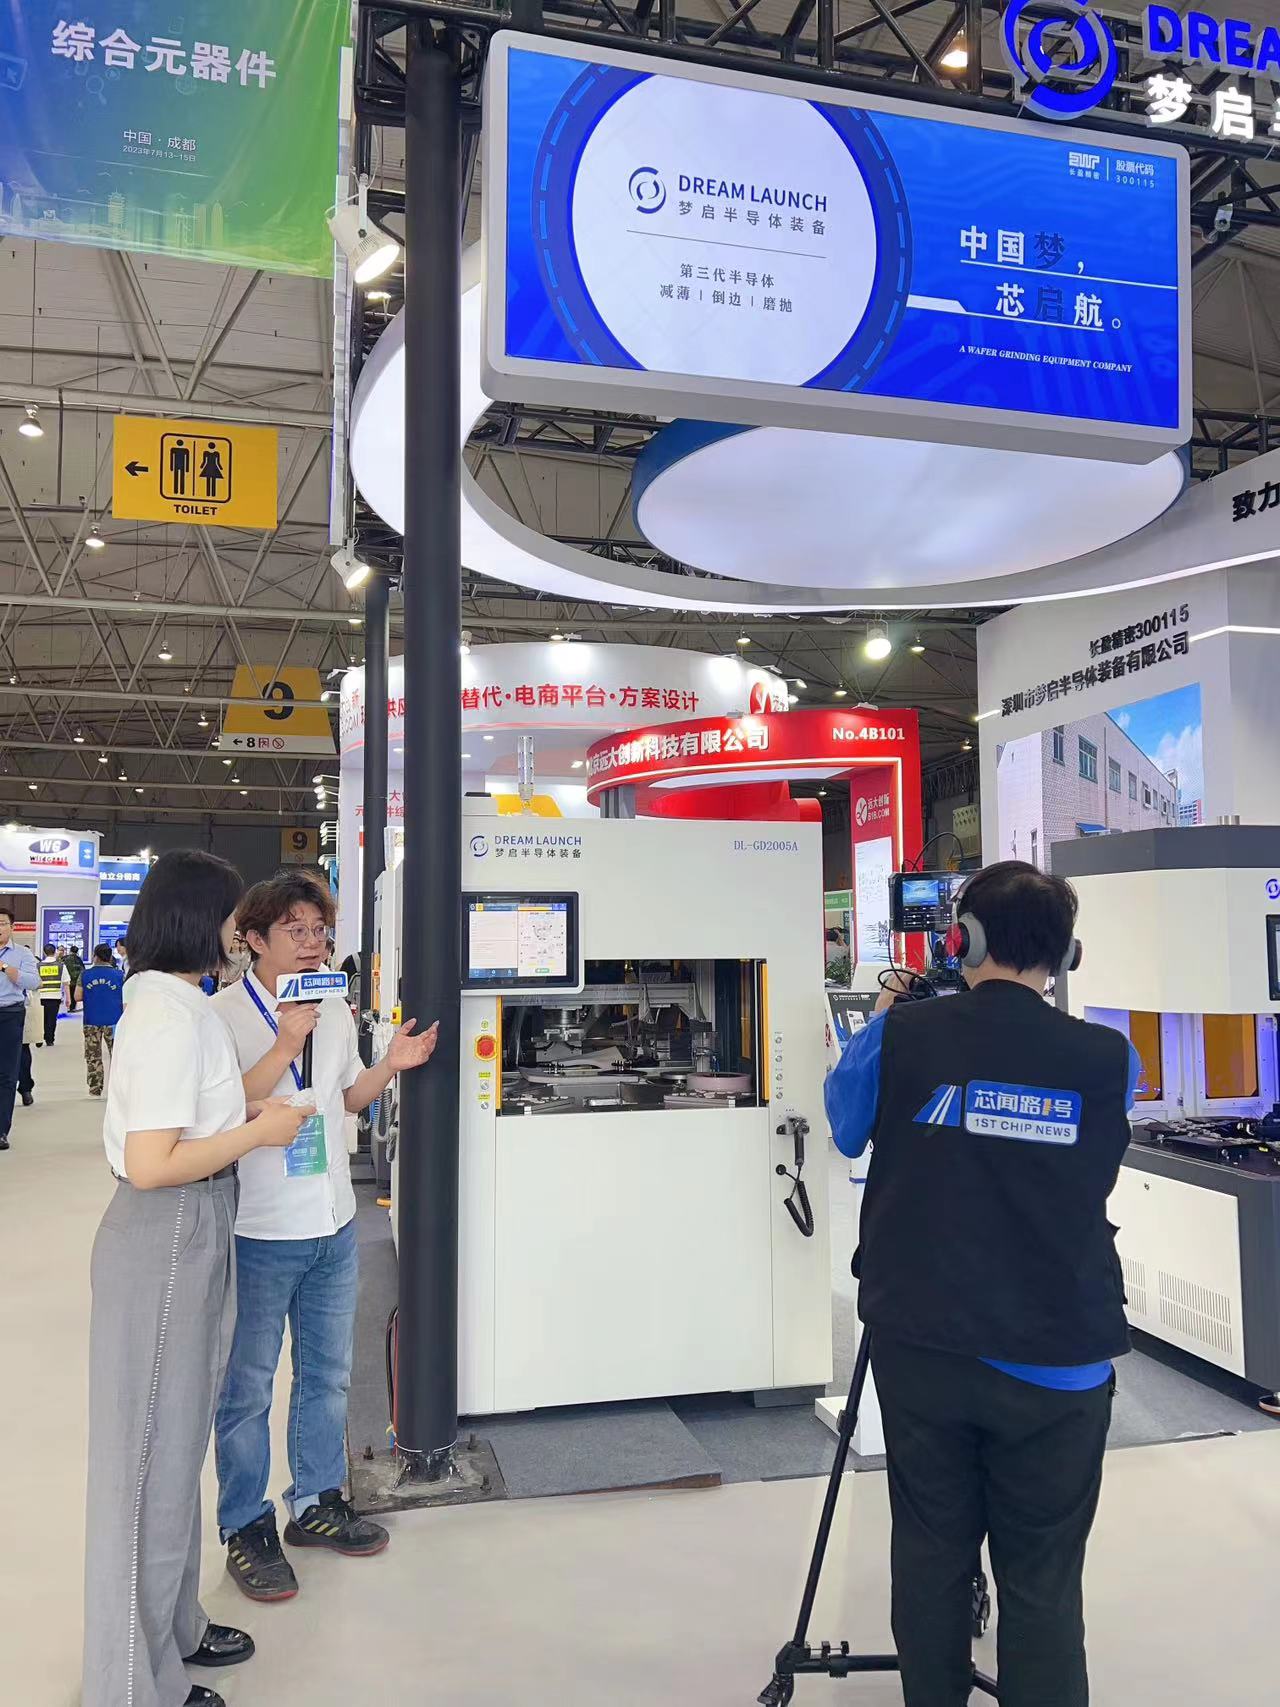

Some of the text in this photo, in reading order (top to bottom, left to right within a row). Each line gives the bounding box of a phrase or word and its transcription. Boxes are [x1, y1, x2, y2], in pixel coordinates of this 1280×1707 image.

[51, 19, 277, 89] 综合元器件
[1146, 74, 1280, 141] 梦启
[1115, 159, 1154, 176] 股票代码
[1115, 175, 1155, 188] 300115
[678, 174, 827, 212] DREAM LAUNCH
[678, 200, 826, 236] 梦启半导体装备
[680, 263, 775, 288] 第三代半导体
[660, 283, 793, 313] 减薄 倒边 磨抛
[959, 345, 1133, 373] A WAFER GRINDING EQUIPMENT COMPANY
[173, 504, 218, 516] TOILET
[1089, 603, 1190, 659] 长盈精密300115
[1001, 630, 1190, 717] 深圳市梦启半导体装备有限公司
[262, 681, 295, 720] 9
[246, 737, 256, 748] 8
[832, 726, 906, 741] No.4B101
[39, 839, 62, 853] WG
[292, 831, 308, 850] 9
[494, 835, 582, 846] DREAM LAUNCH
[733, 840, 799, 852] DL-GD2005A
[494, 848, 582, 859] 梦启半导体装备
[974, 1089, 1073, 1118] 芯闻路1号
[974, 1117, 1072, 1137] 1ST CHIP NEWS
